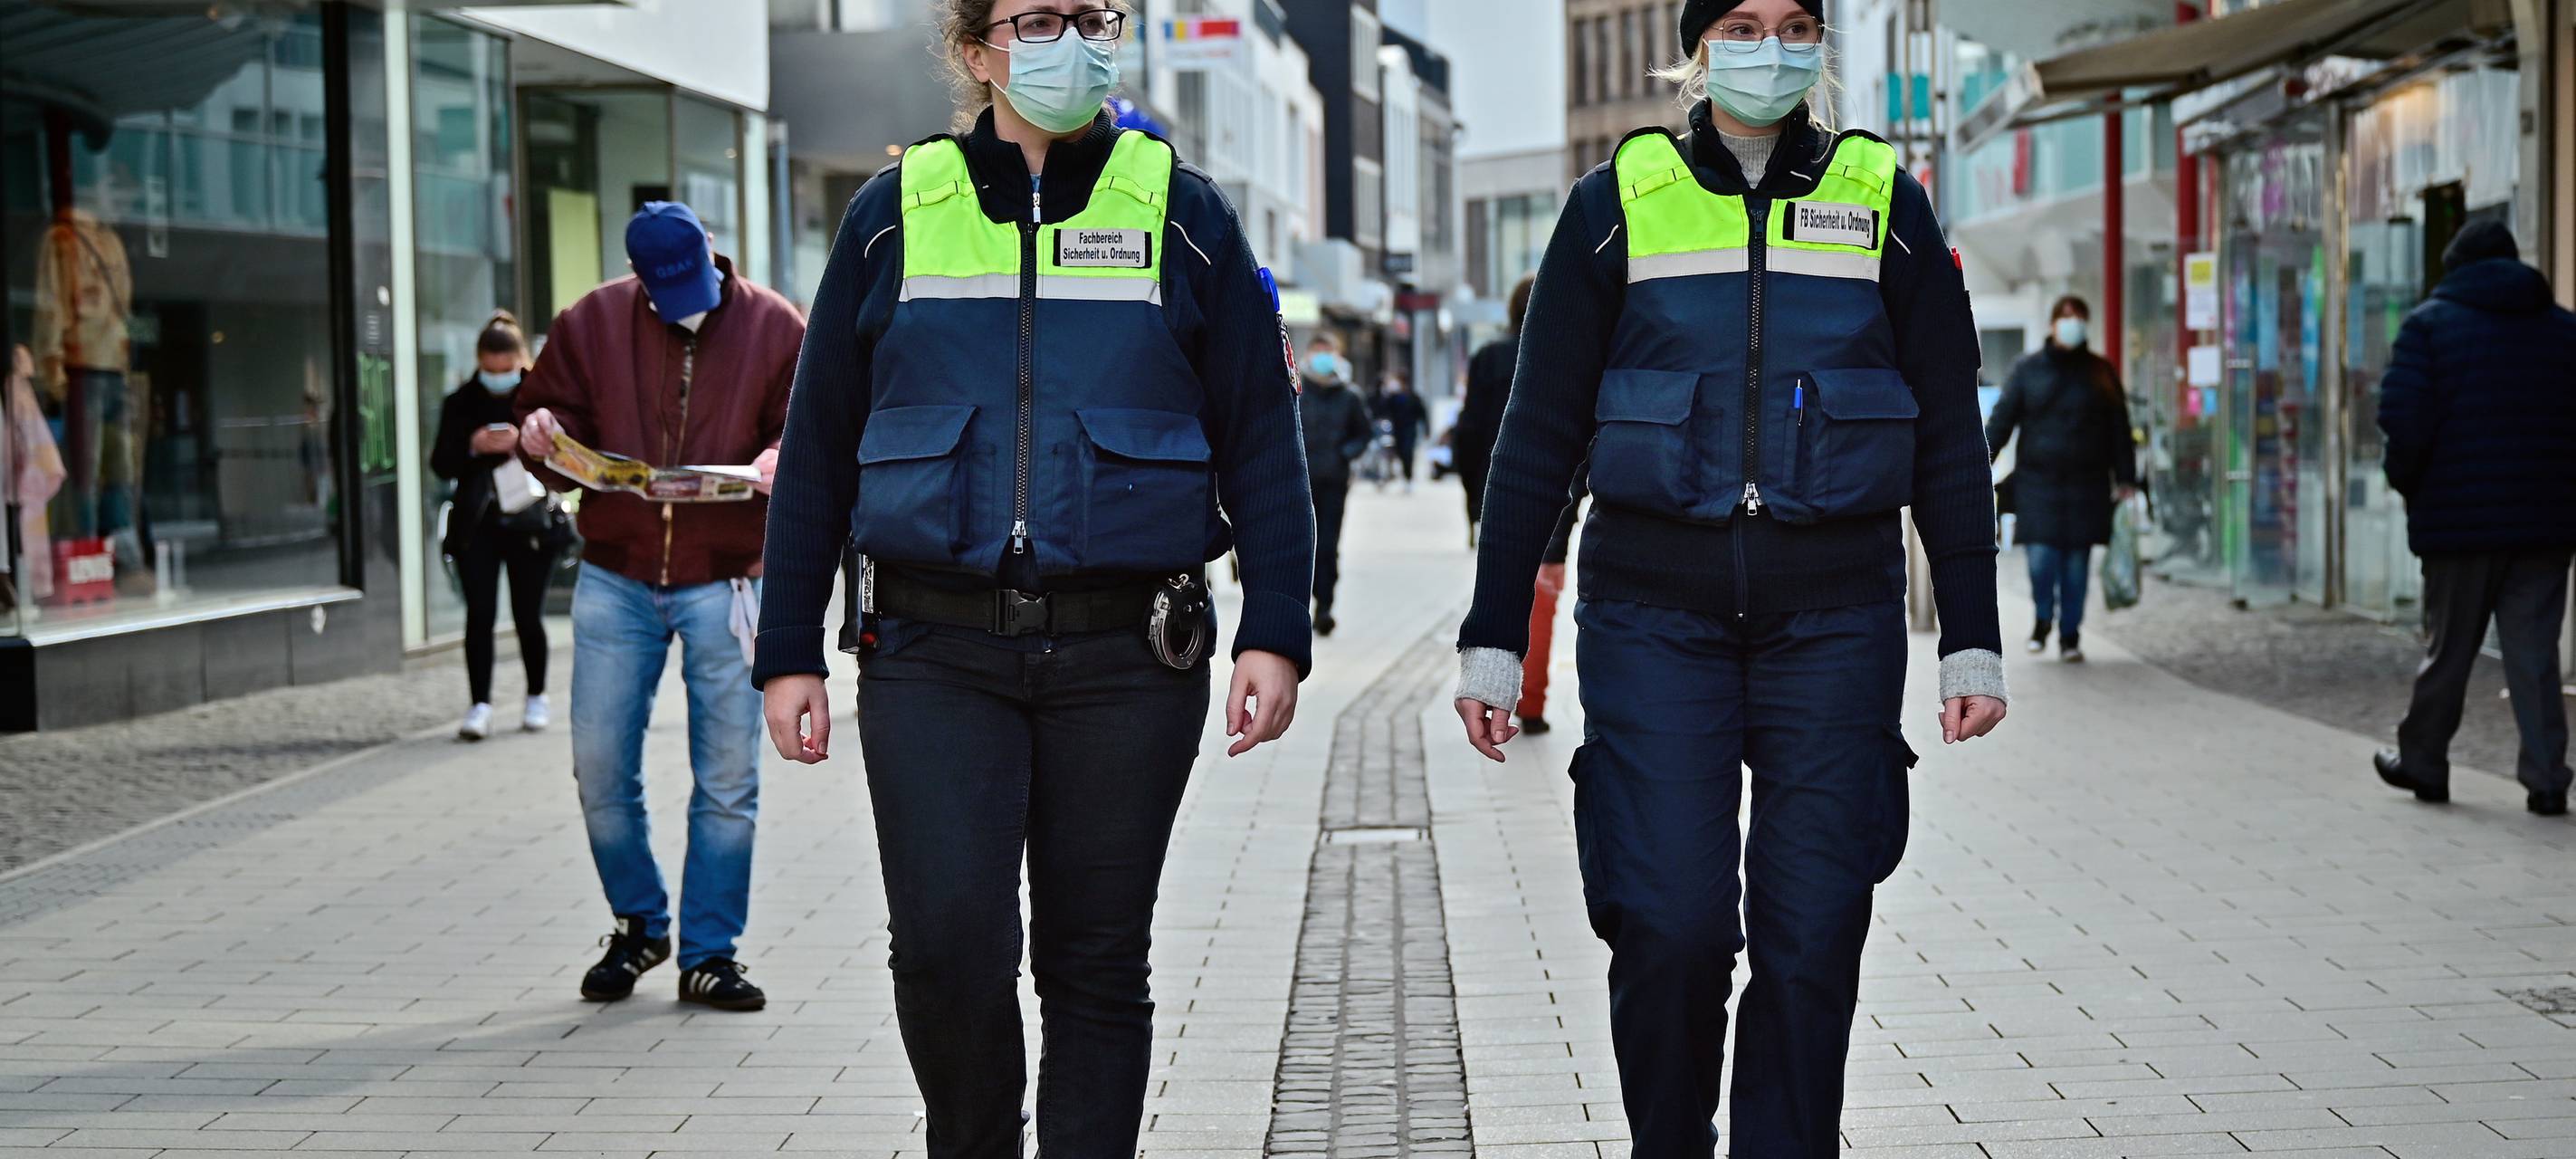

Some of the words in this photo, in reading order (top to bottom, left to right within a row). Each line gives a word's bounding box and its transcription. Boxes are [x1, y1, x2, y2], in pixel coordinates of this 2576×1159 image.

[1800, 207, 1809, 227] FB
[1810, 208, 1840, 230] Sicherheit
[1841, 215, 1846, 230] u.
[1848, 211, 1870, 238] Ordnung
[1079, 232, 1123, 244] Fachbereich
[1063, 247, 1100, 260] Sicherheit
[1102, 250, 1109, 260] u.
[1110, 247, 1140, 263] Ordnung
